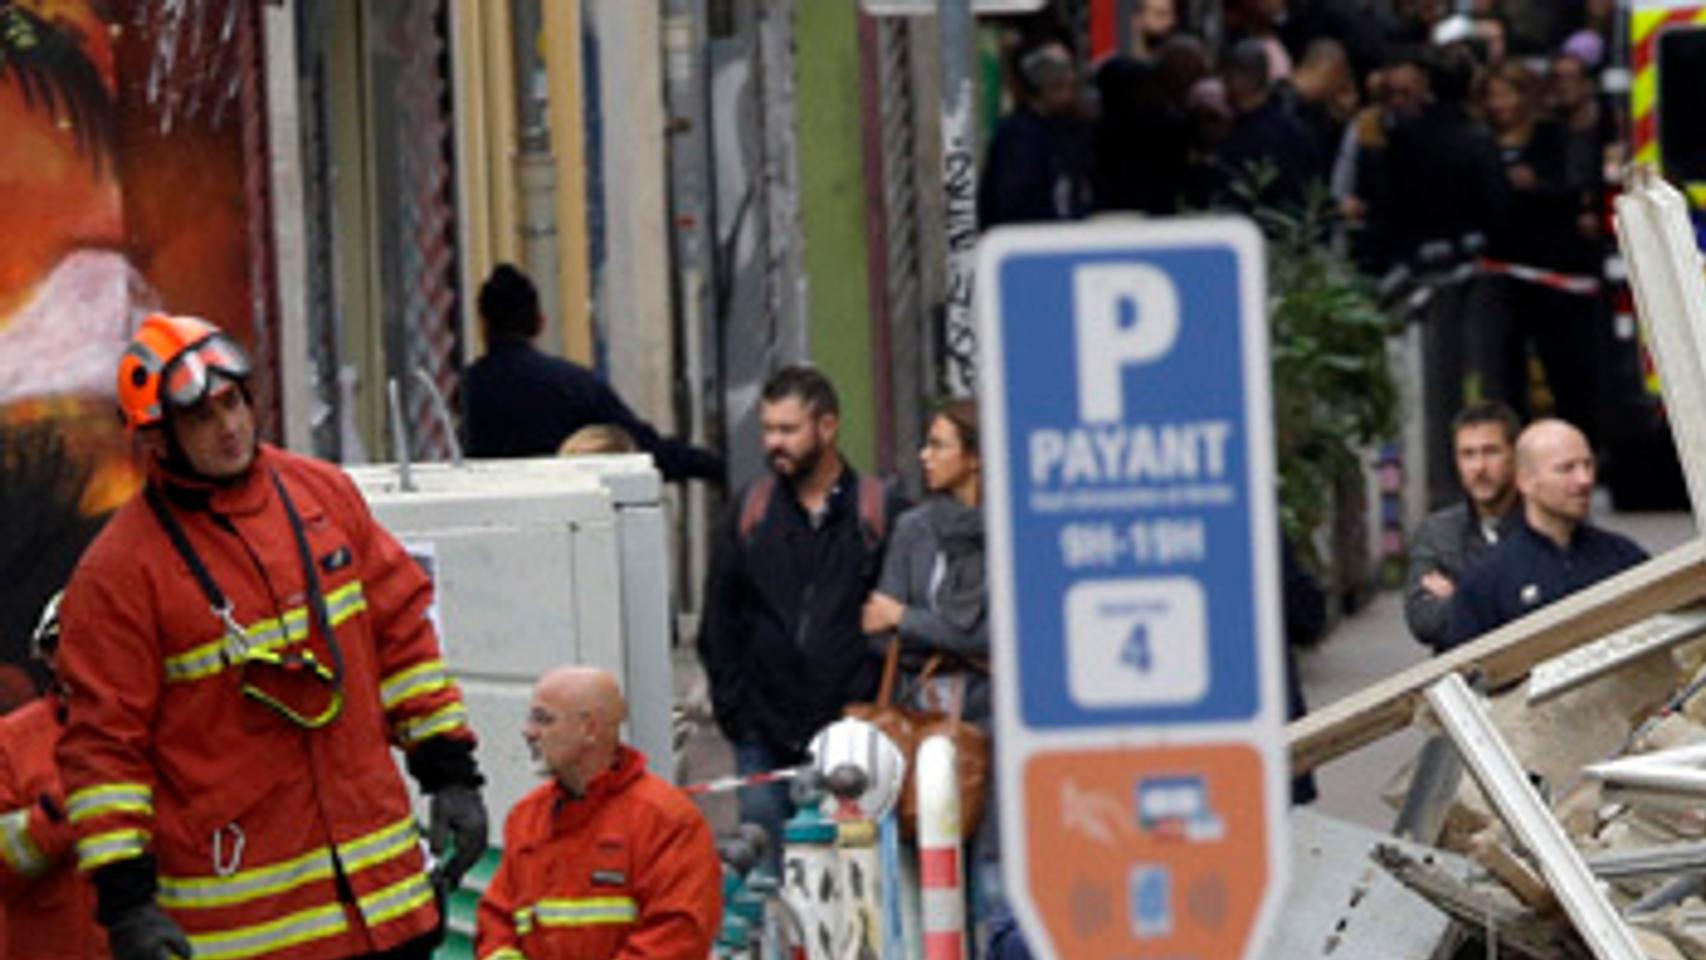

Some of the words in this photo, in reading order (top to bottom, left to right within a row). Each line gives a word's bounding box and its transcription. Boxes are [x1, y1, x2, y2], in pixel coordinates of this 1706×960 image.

[1072, 262, 1181, 424] P
[1029, 421, 1232, 485] PAYANT
[1118, 623, 1153, 675] 4
